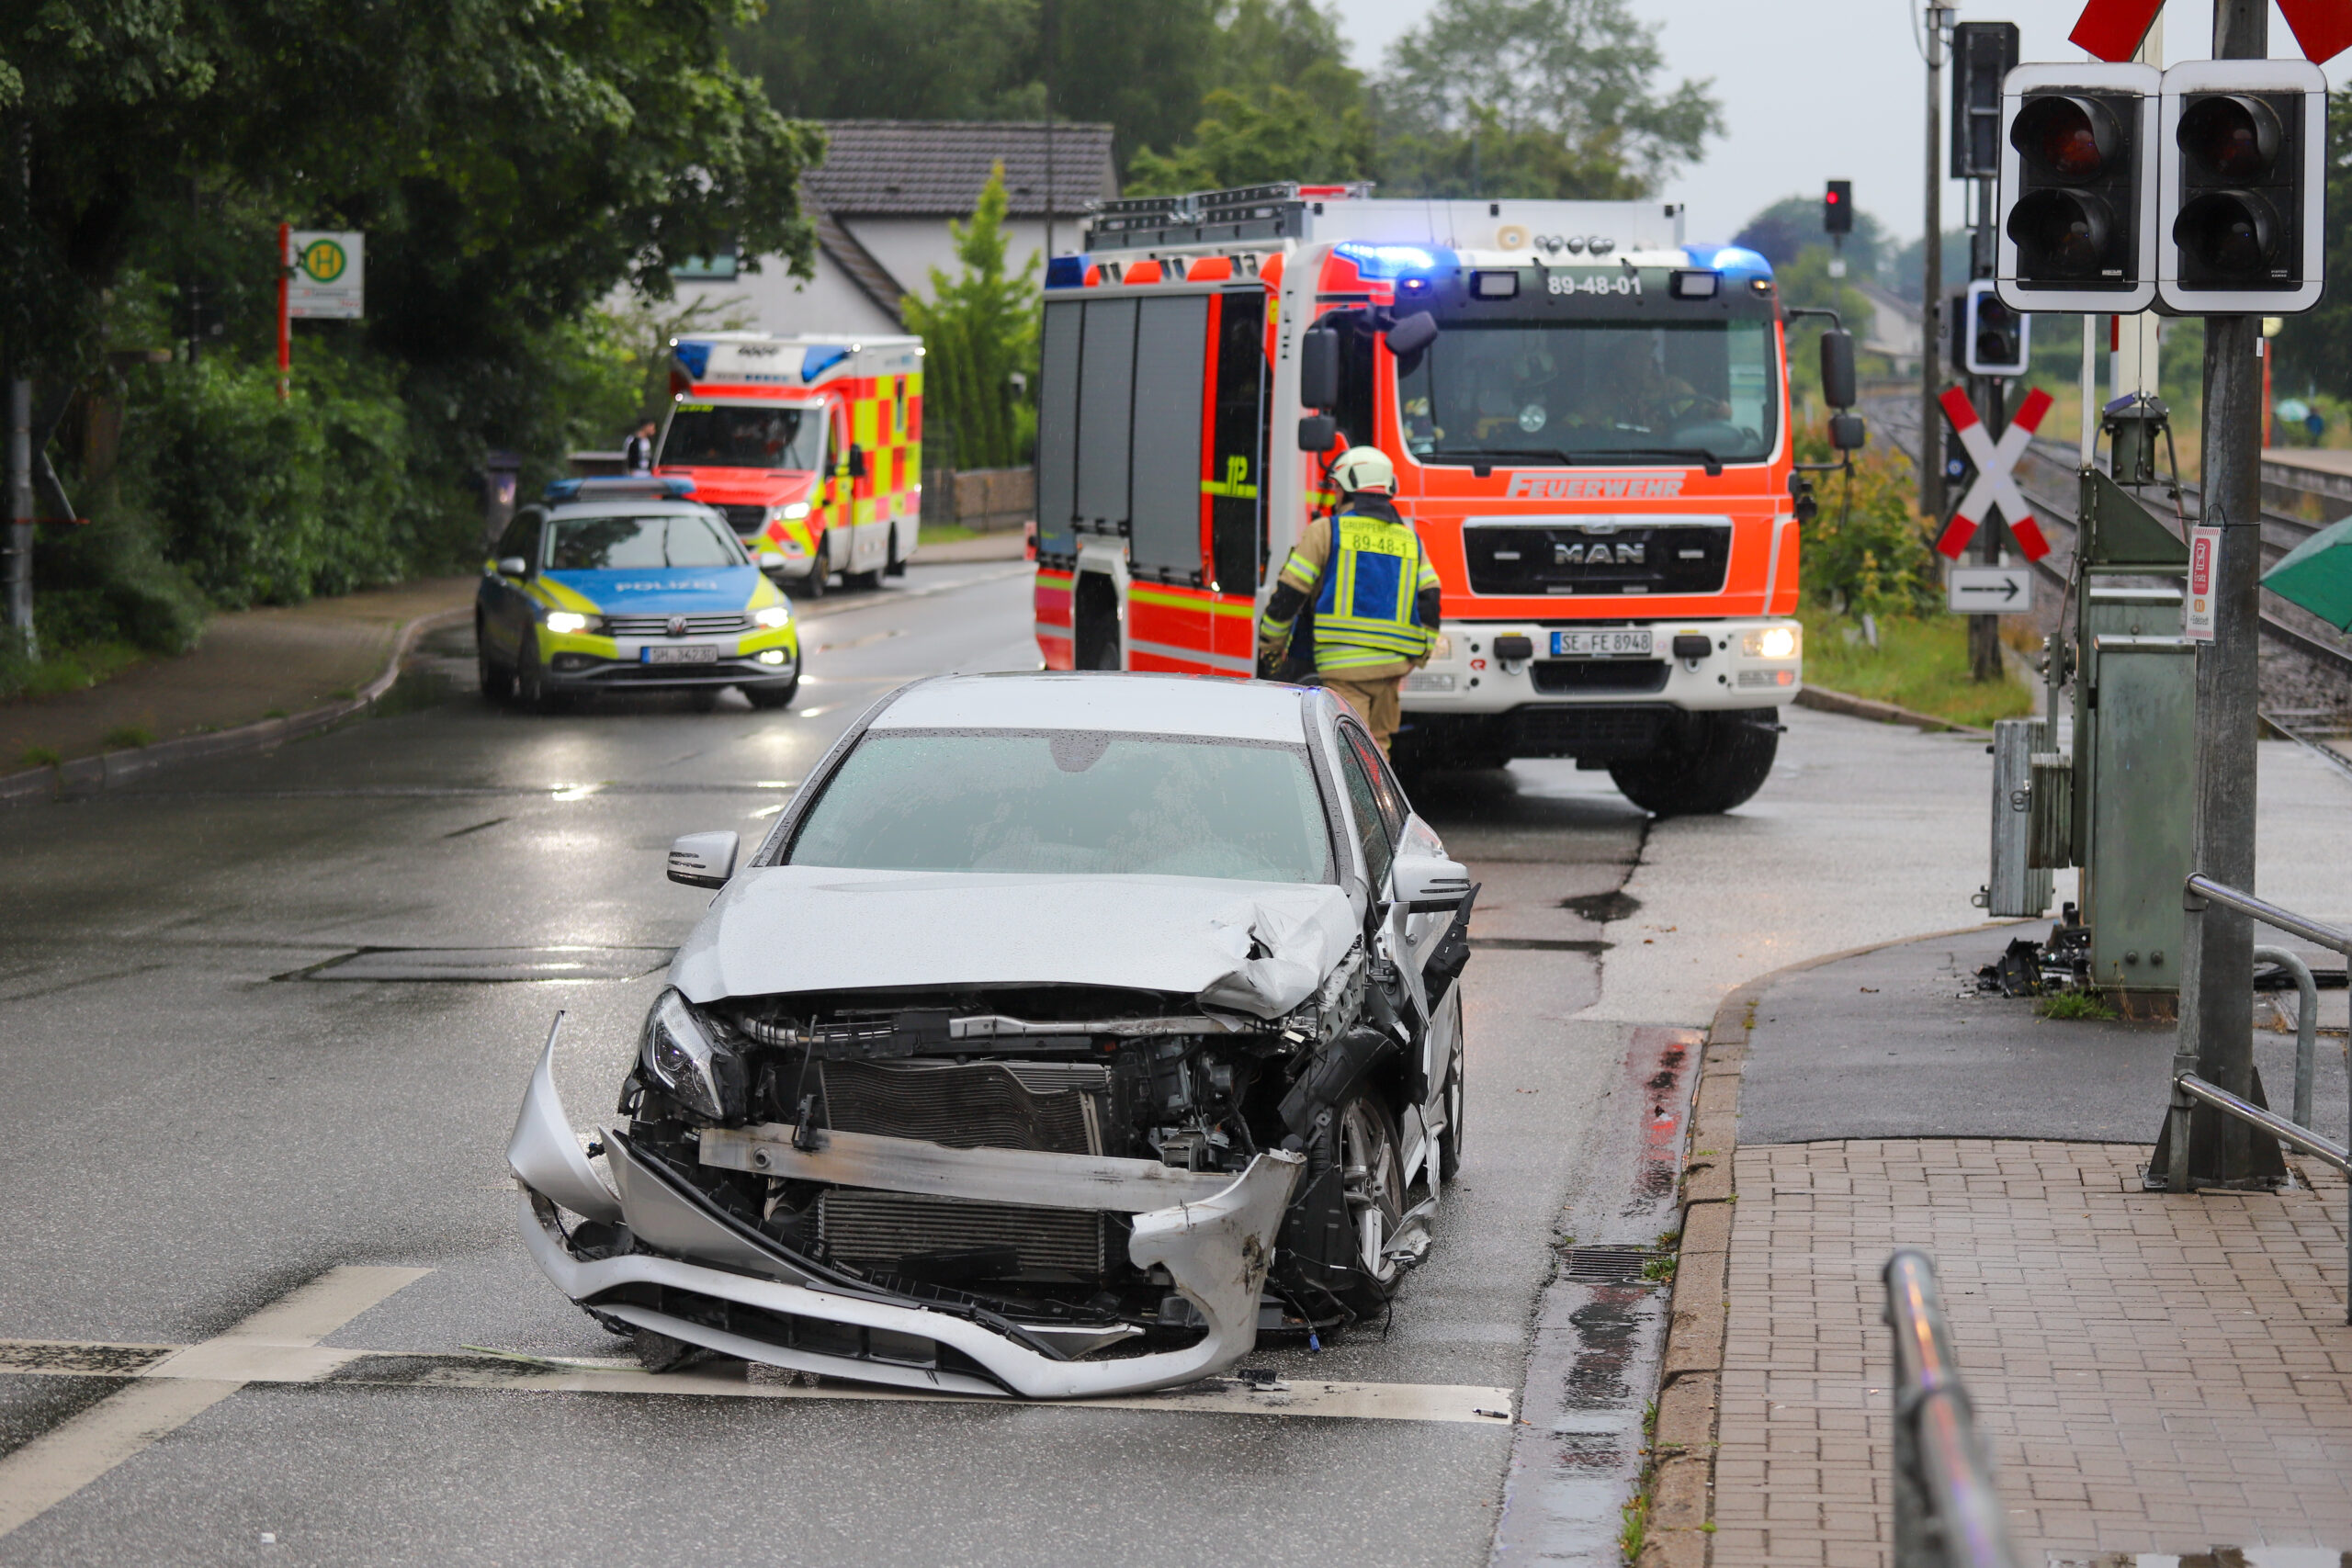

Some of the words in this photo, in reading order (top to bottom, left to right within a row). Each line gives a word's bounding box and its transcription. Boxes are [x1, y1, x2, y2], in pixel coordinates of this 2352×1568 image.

[1547, 276, 1642, 296] 89-48-01
[1505, 471, 1687, 498] FEUERWEHR
[1352, 535, 1408, 558] 89-48-1
[1554, 543, 1645, 565] MAN
[615, 581, 718, 592] POLIZEI
[1561, 635, 1580, 651] SE
[1591, 635, 1610, 650] FE
[1613, 635, 1648, 650] 8948
